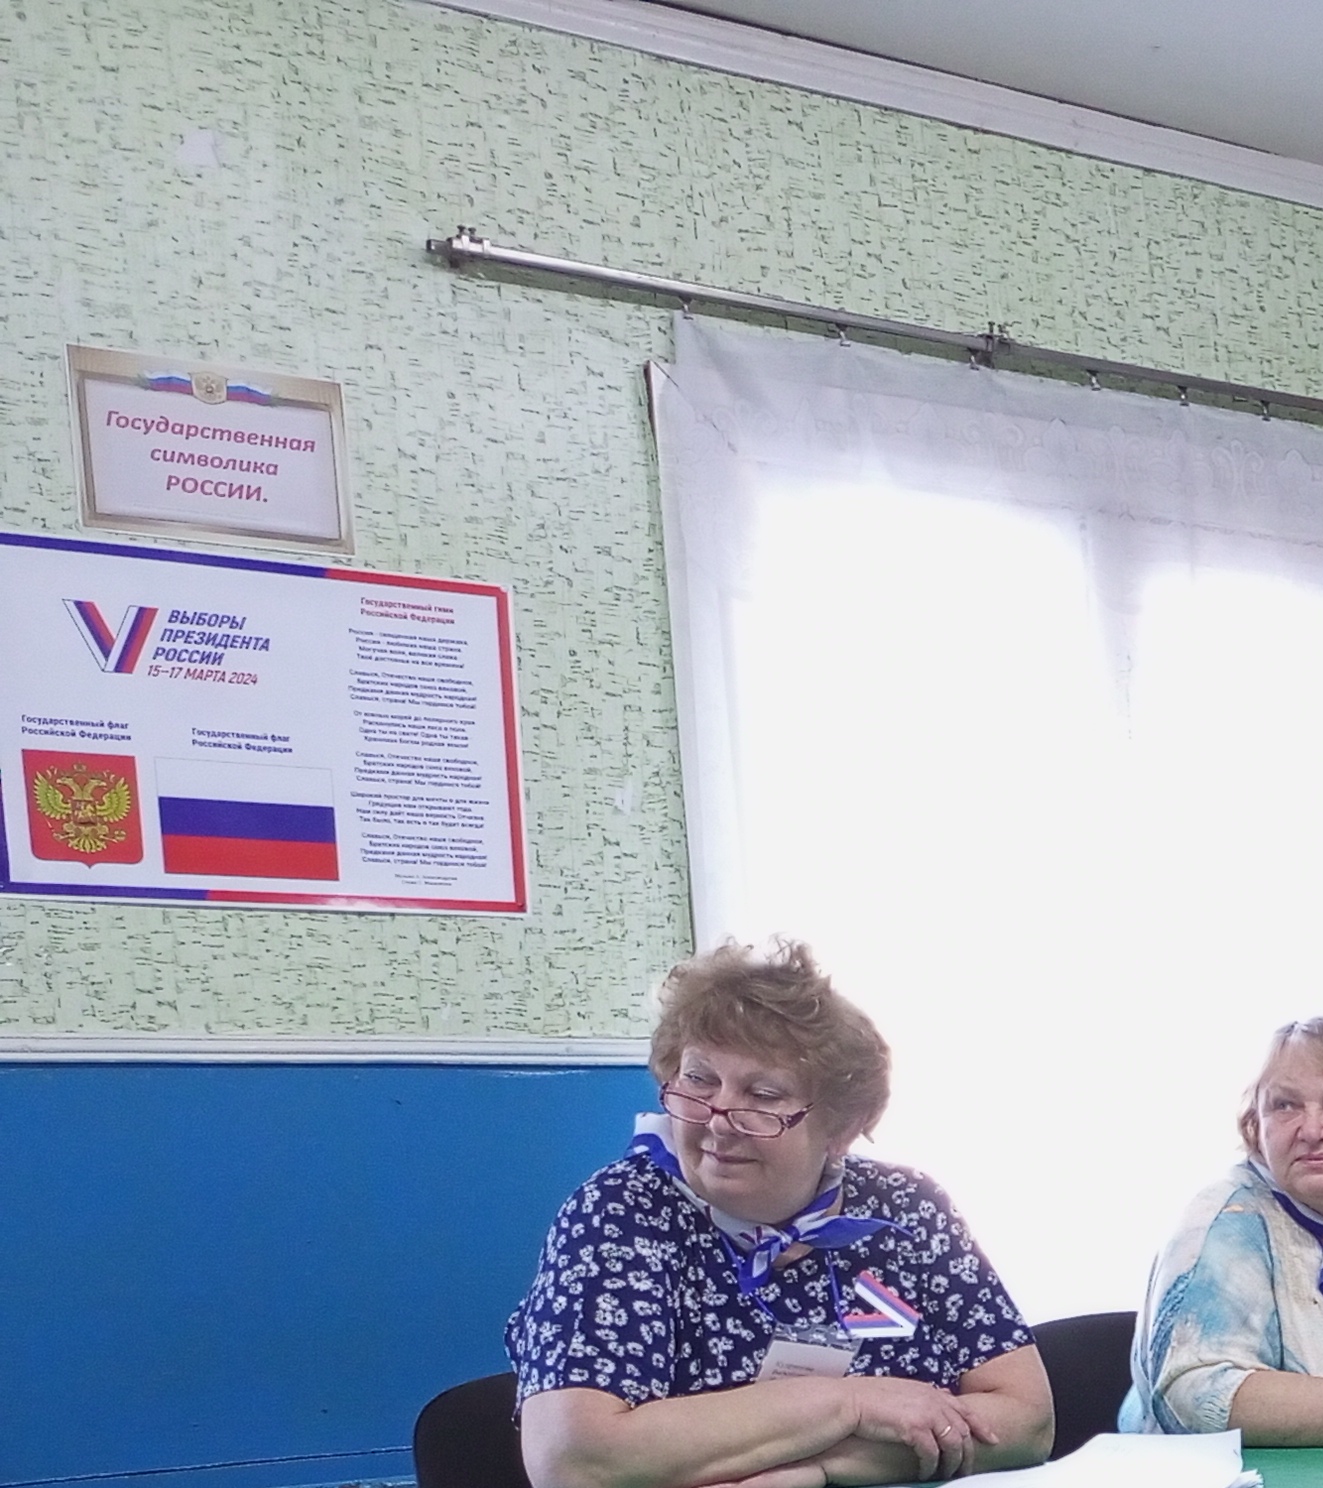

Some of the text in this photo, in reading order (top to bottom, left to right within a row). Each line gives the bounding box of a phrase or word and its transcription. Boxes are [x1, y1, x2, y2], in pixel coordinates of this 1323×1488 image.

[106, 410, 316, 453] Государственная
[150, 448, 278, 476] символика
[166, 475, 268, 503] РОССИИ.
[168, 610, 246, 630] ВЫБОРЫ
[160, 628, 270, 651] ПРЕЗИДЕНТА
[153, 647, 224, 666] РОССИИ
[184, 668, 226, 683] МАРТА
[228, 671, 257, 686] 2024
[21, 714, 105, 729] Государственный
[21, 726, 131, 743] Российской Федерации
